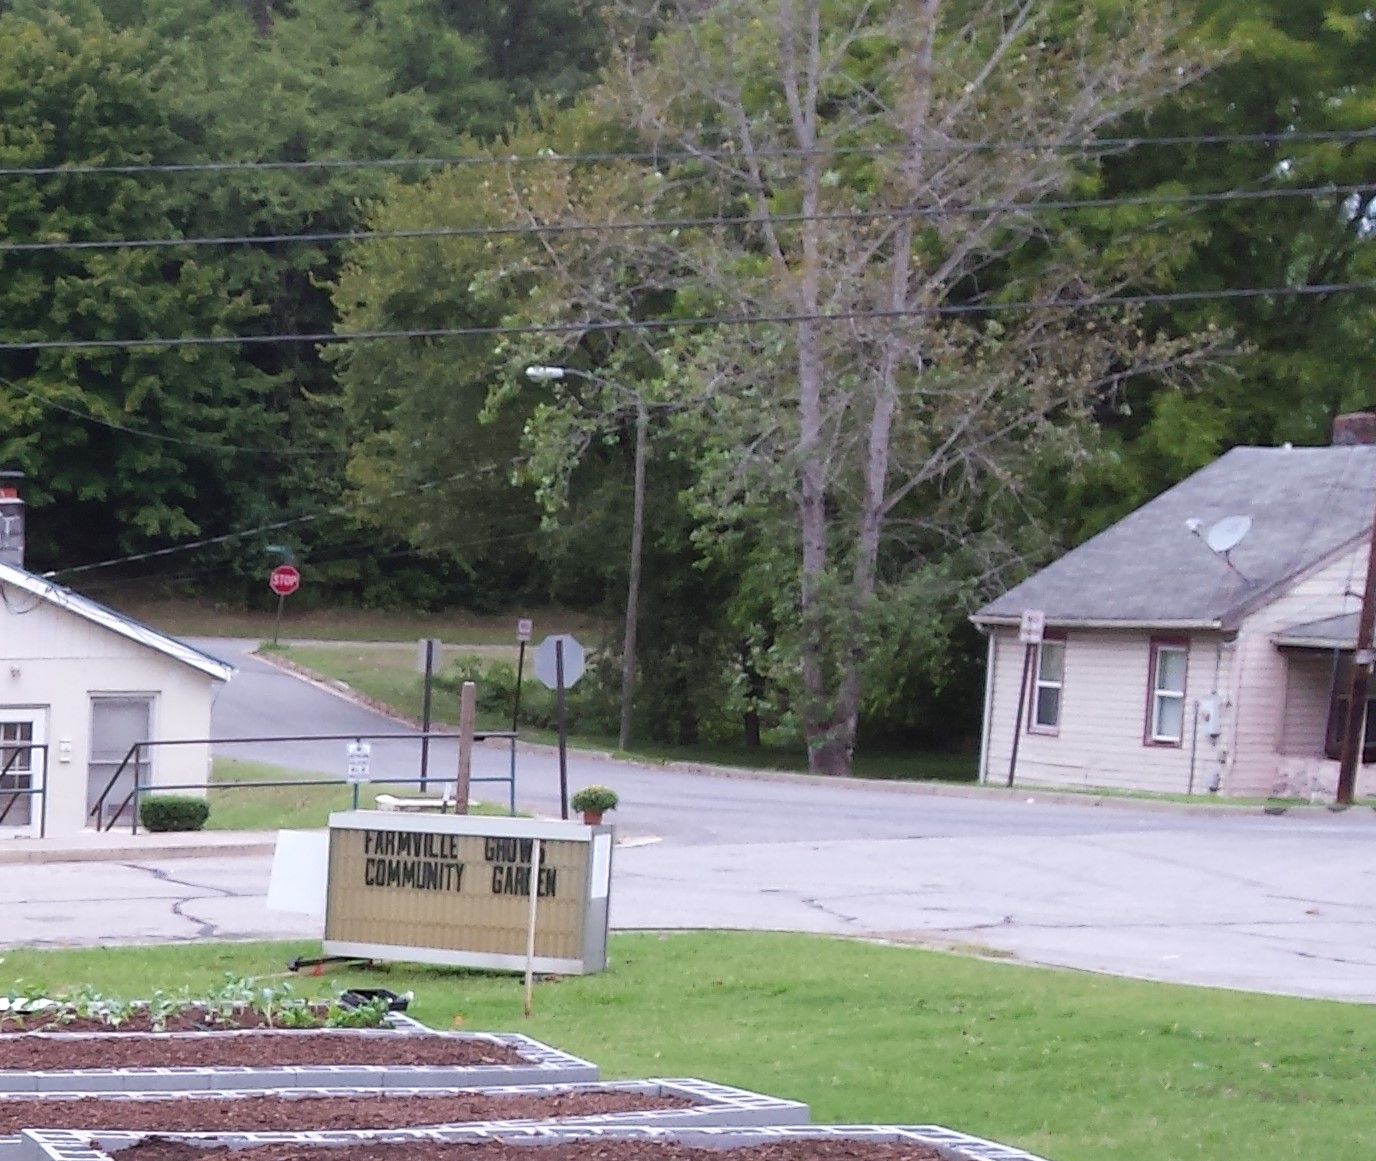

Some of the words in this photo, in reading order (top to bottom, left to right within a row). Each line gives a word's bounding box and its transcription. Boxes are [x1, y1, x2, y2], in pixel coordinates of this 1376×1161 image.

[272, 574, 297, 586] STOP
[364, 831, 458, 859] FARMVILLE
[365, 858, 465, 892] COMMUNITY
